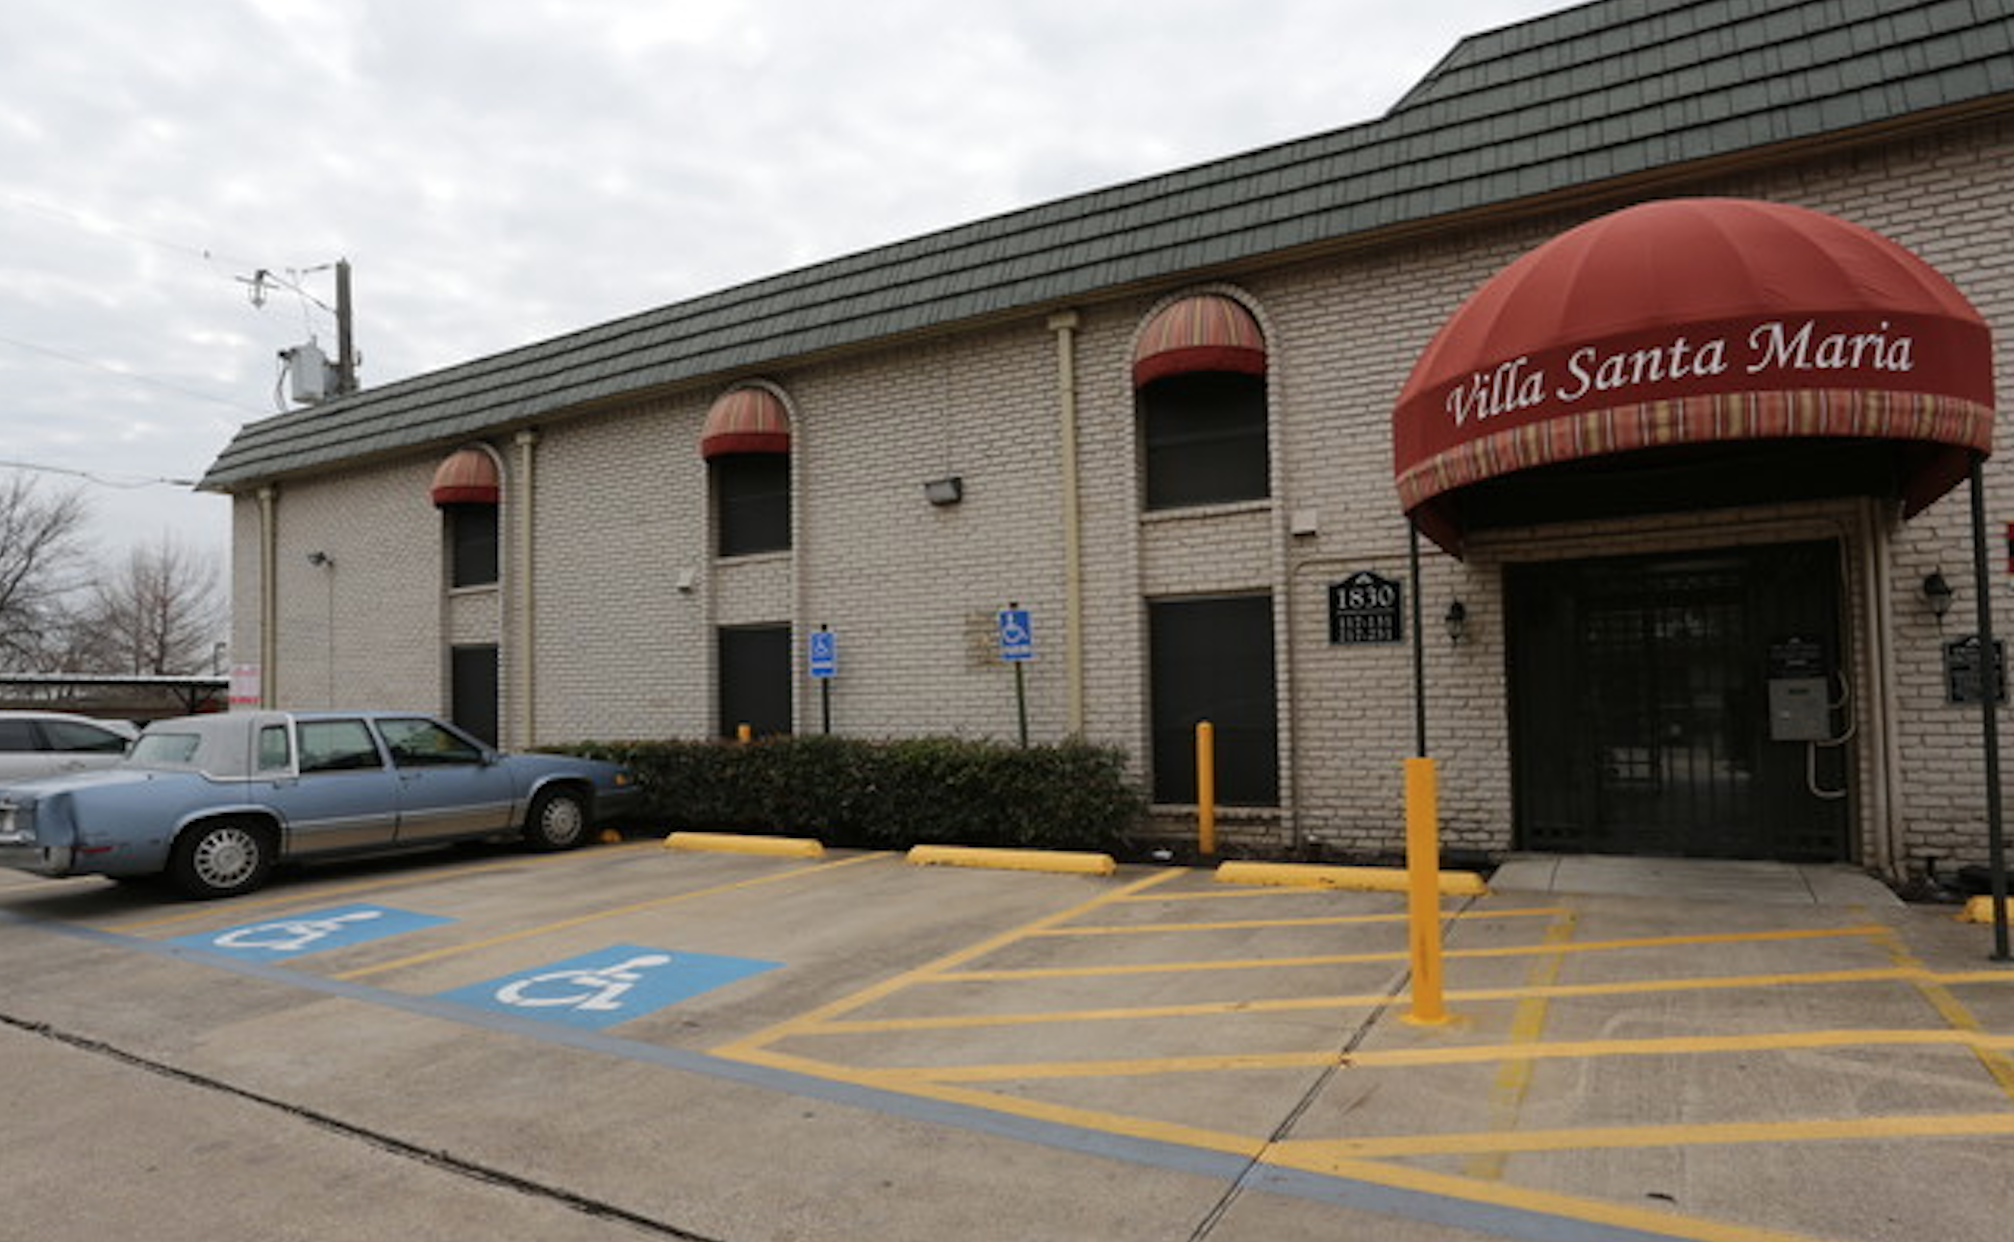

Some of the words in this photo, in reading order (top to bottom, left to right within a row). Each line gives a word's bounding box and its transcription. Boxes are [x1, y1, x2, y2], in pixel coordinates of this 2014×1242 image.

[1447, 357, 1546, 427] Villa
[1556, 336, 1727, 402] Santa
[1746, 320, 1915, 374] Maria
[1336, 585, 1395, 609] 1830
